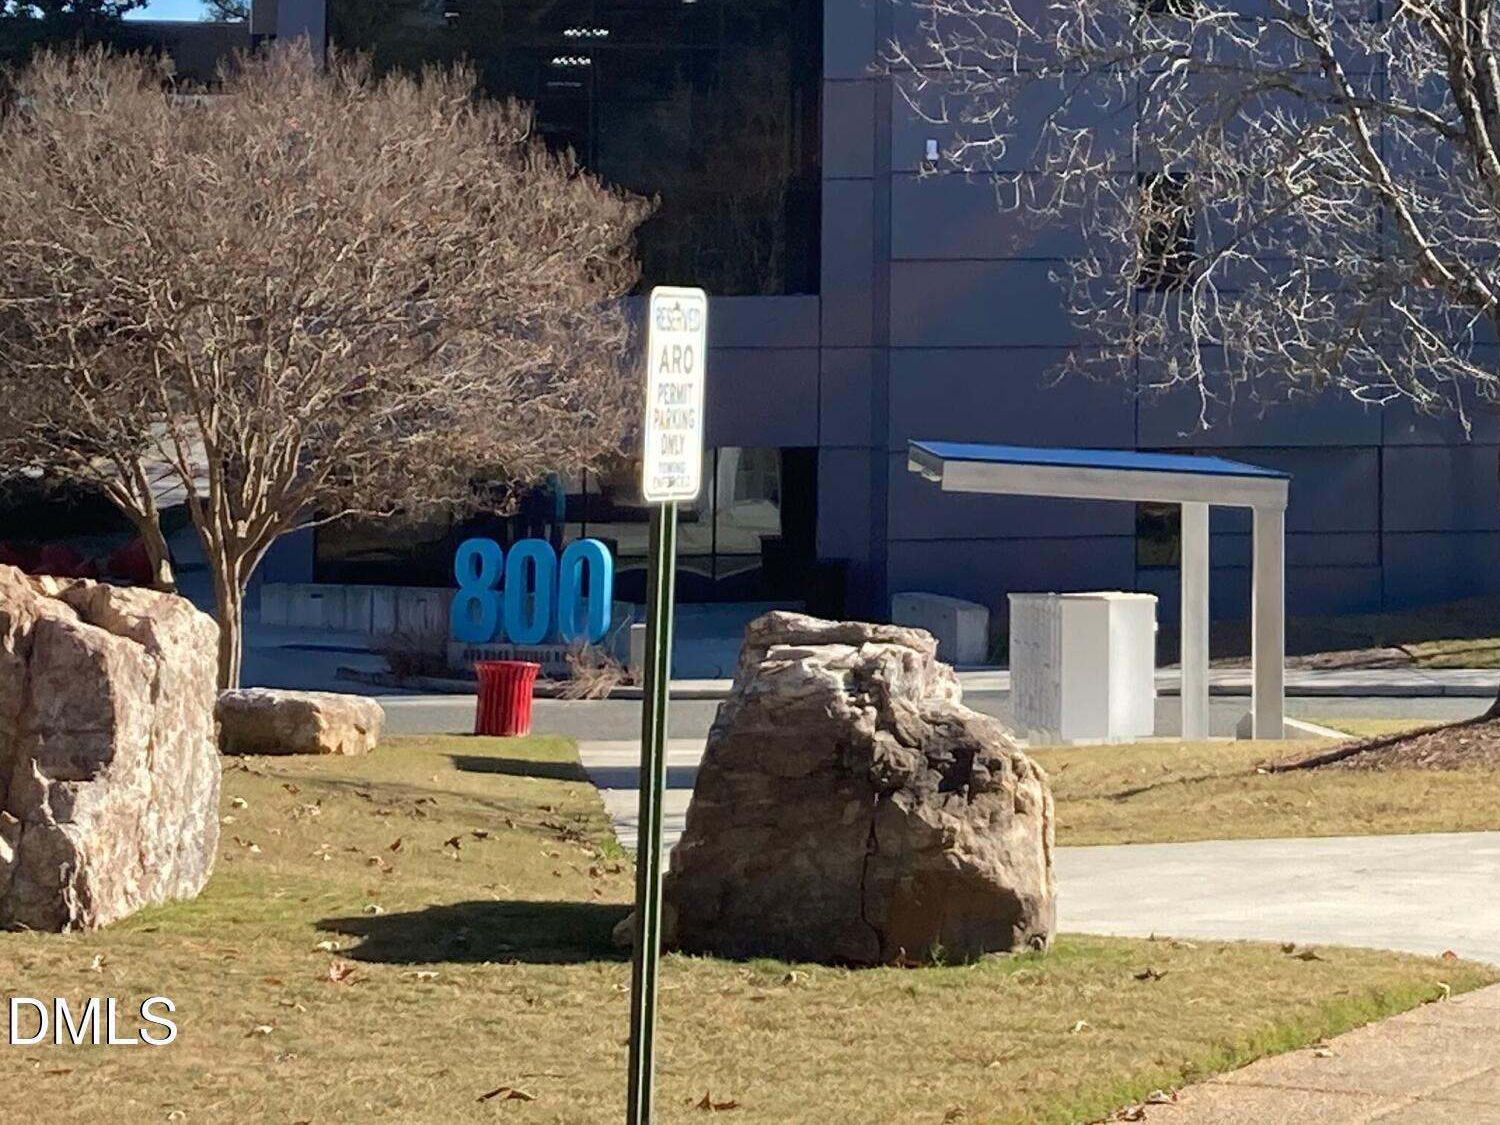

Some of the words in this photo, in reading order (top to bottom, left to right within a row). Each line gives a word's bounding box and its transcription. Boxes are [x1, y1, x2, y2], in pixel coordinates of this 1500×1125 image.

[656, 306, 700, 332] RESVED
[659, 345, 694, 374] ARO
[658, 383, 693, 404] PERMIT
[654, 408, 695, 430] PARKING
[661, 434, 685, 455] ONLY
[453, 538, 613, 644] 800
